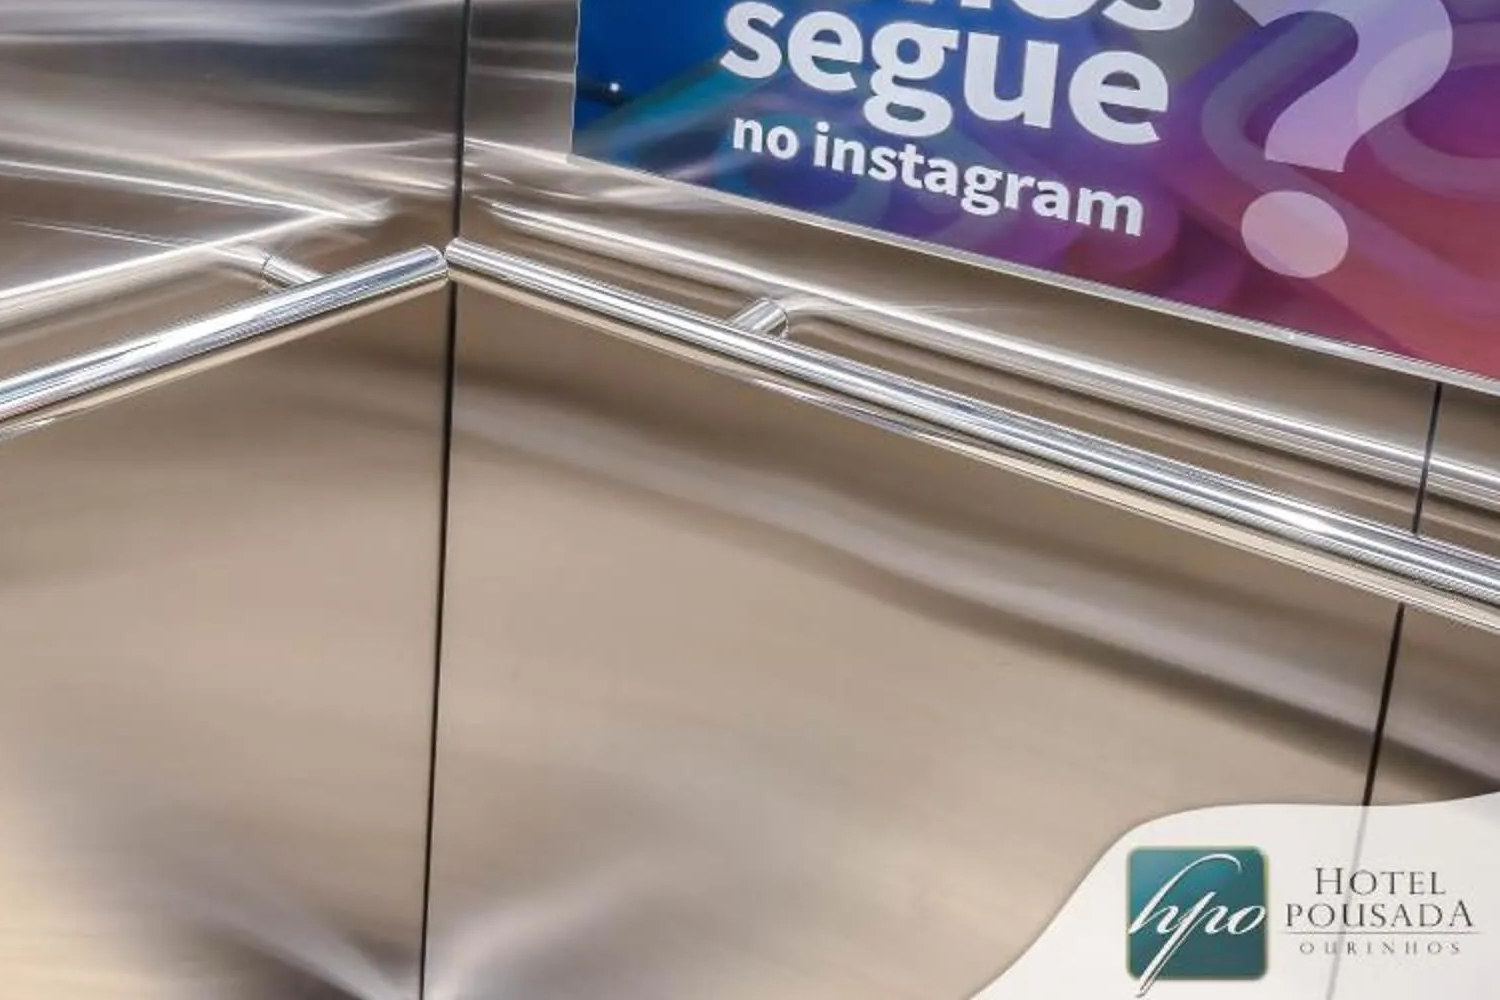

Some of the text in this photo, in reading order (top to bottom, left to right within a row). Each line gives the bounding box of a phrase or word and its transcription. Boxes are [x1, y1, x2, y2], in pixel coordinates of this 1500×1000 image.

[719, 1, 1169, 144] segue
[732, 113, 1144, 236] no instagram
